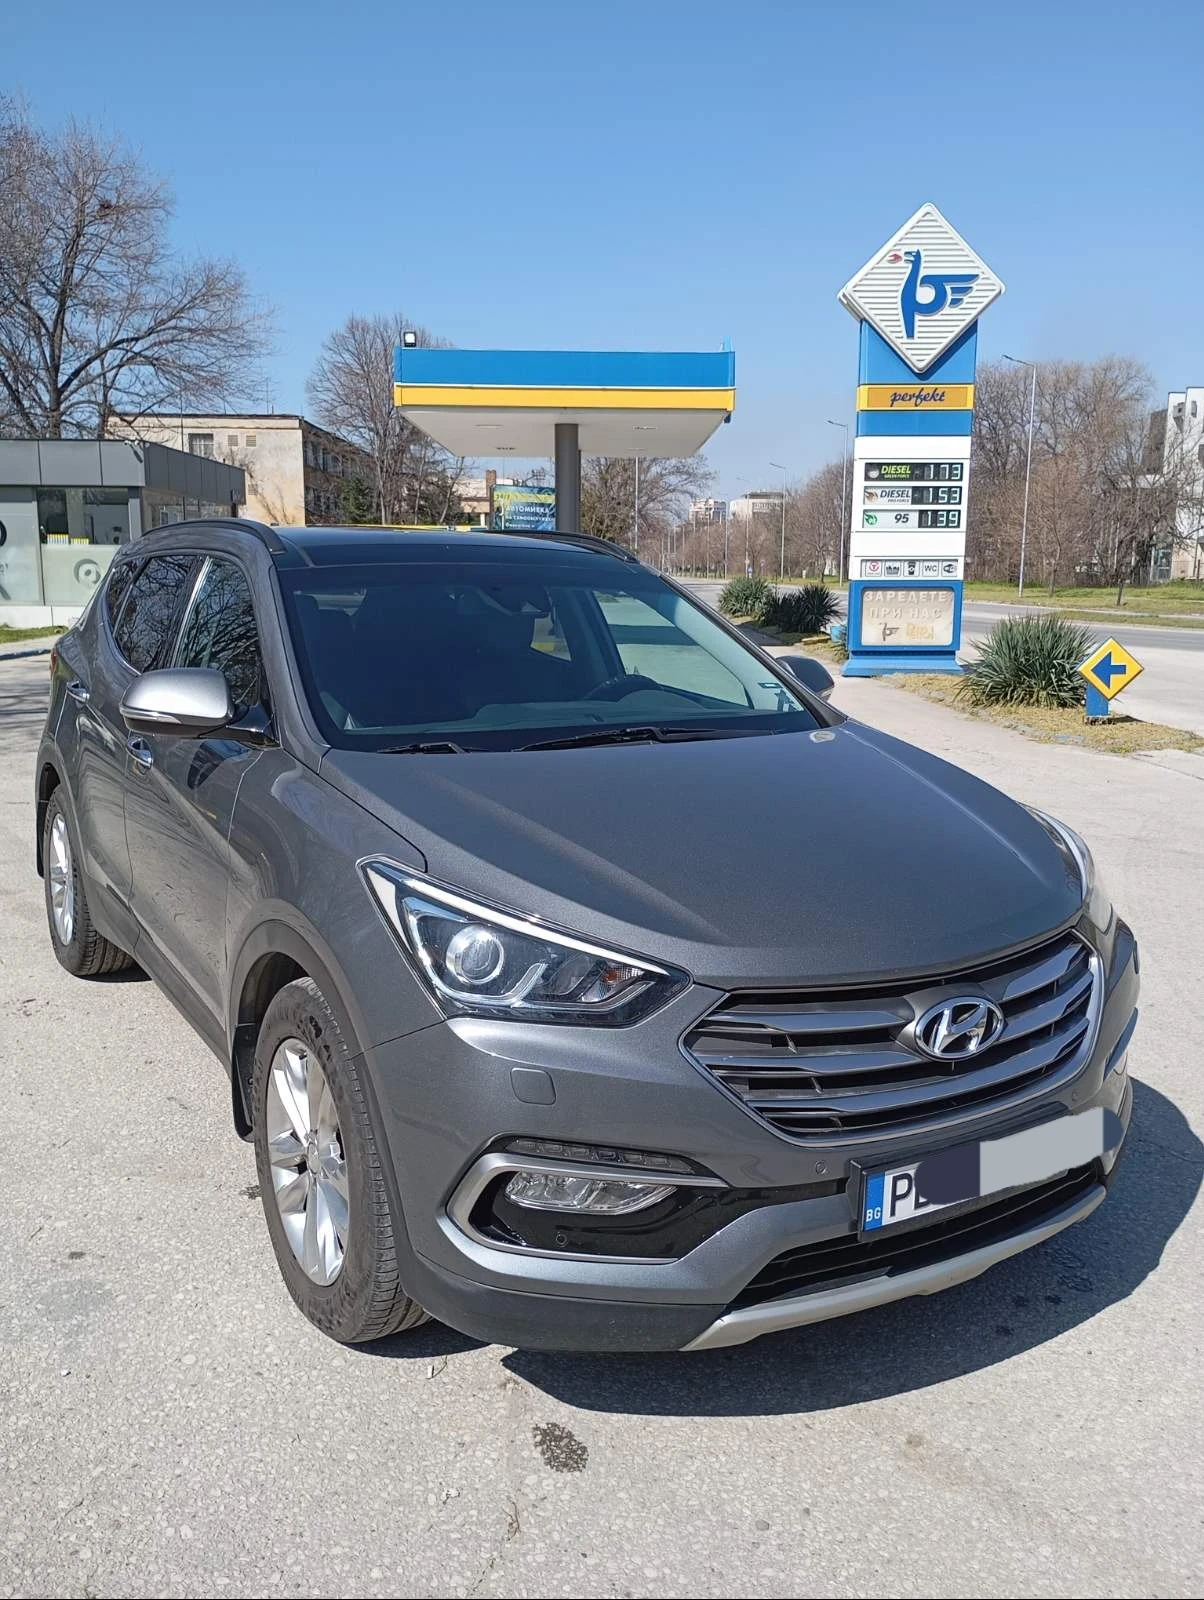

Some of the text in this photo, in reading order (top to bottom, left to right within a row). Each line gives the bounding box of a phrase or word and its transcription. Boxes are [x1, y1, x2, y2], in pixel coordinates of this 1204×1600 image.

[890, 387, 946, 407] perfekt
[881, 465, 912, 474] DIESEL
[880, 489, 911, 498] DIESEL
[894, 513, 910, 524] 95
[924, 564, 937, 572] WC
[864, 591, 947, 604] ЗАРЕДЕТЕ
[870, 607, 943, 620] ПРИ НАС
[866, 1207, 881, 1222] BG
